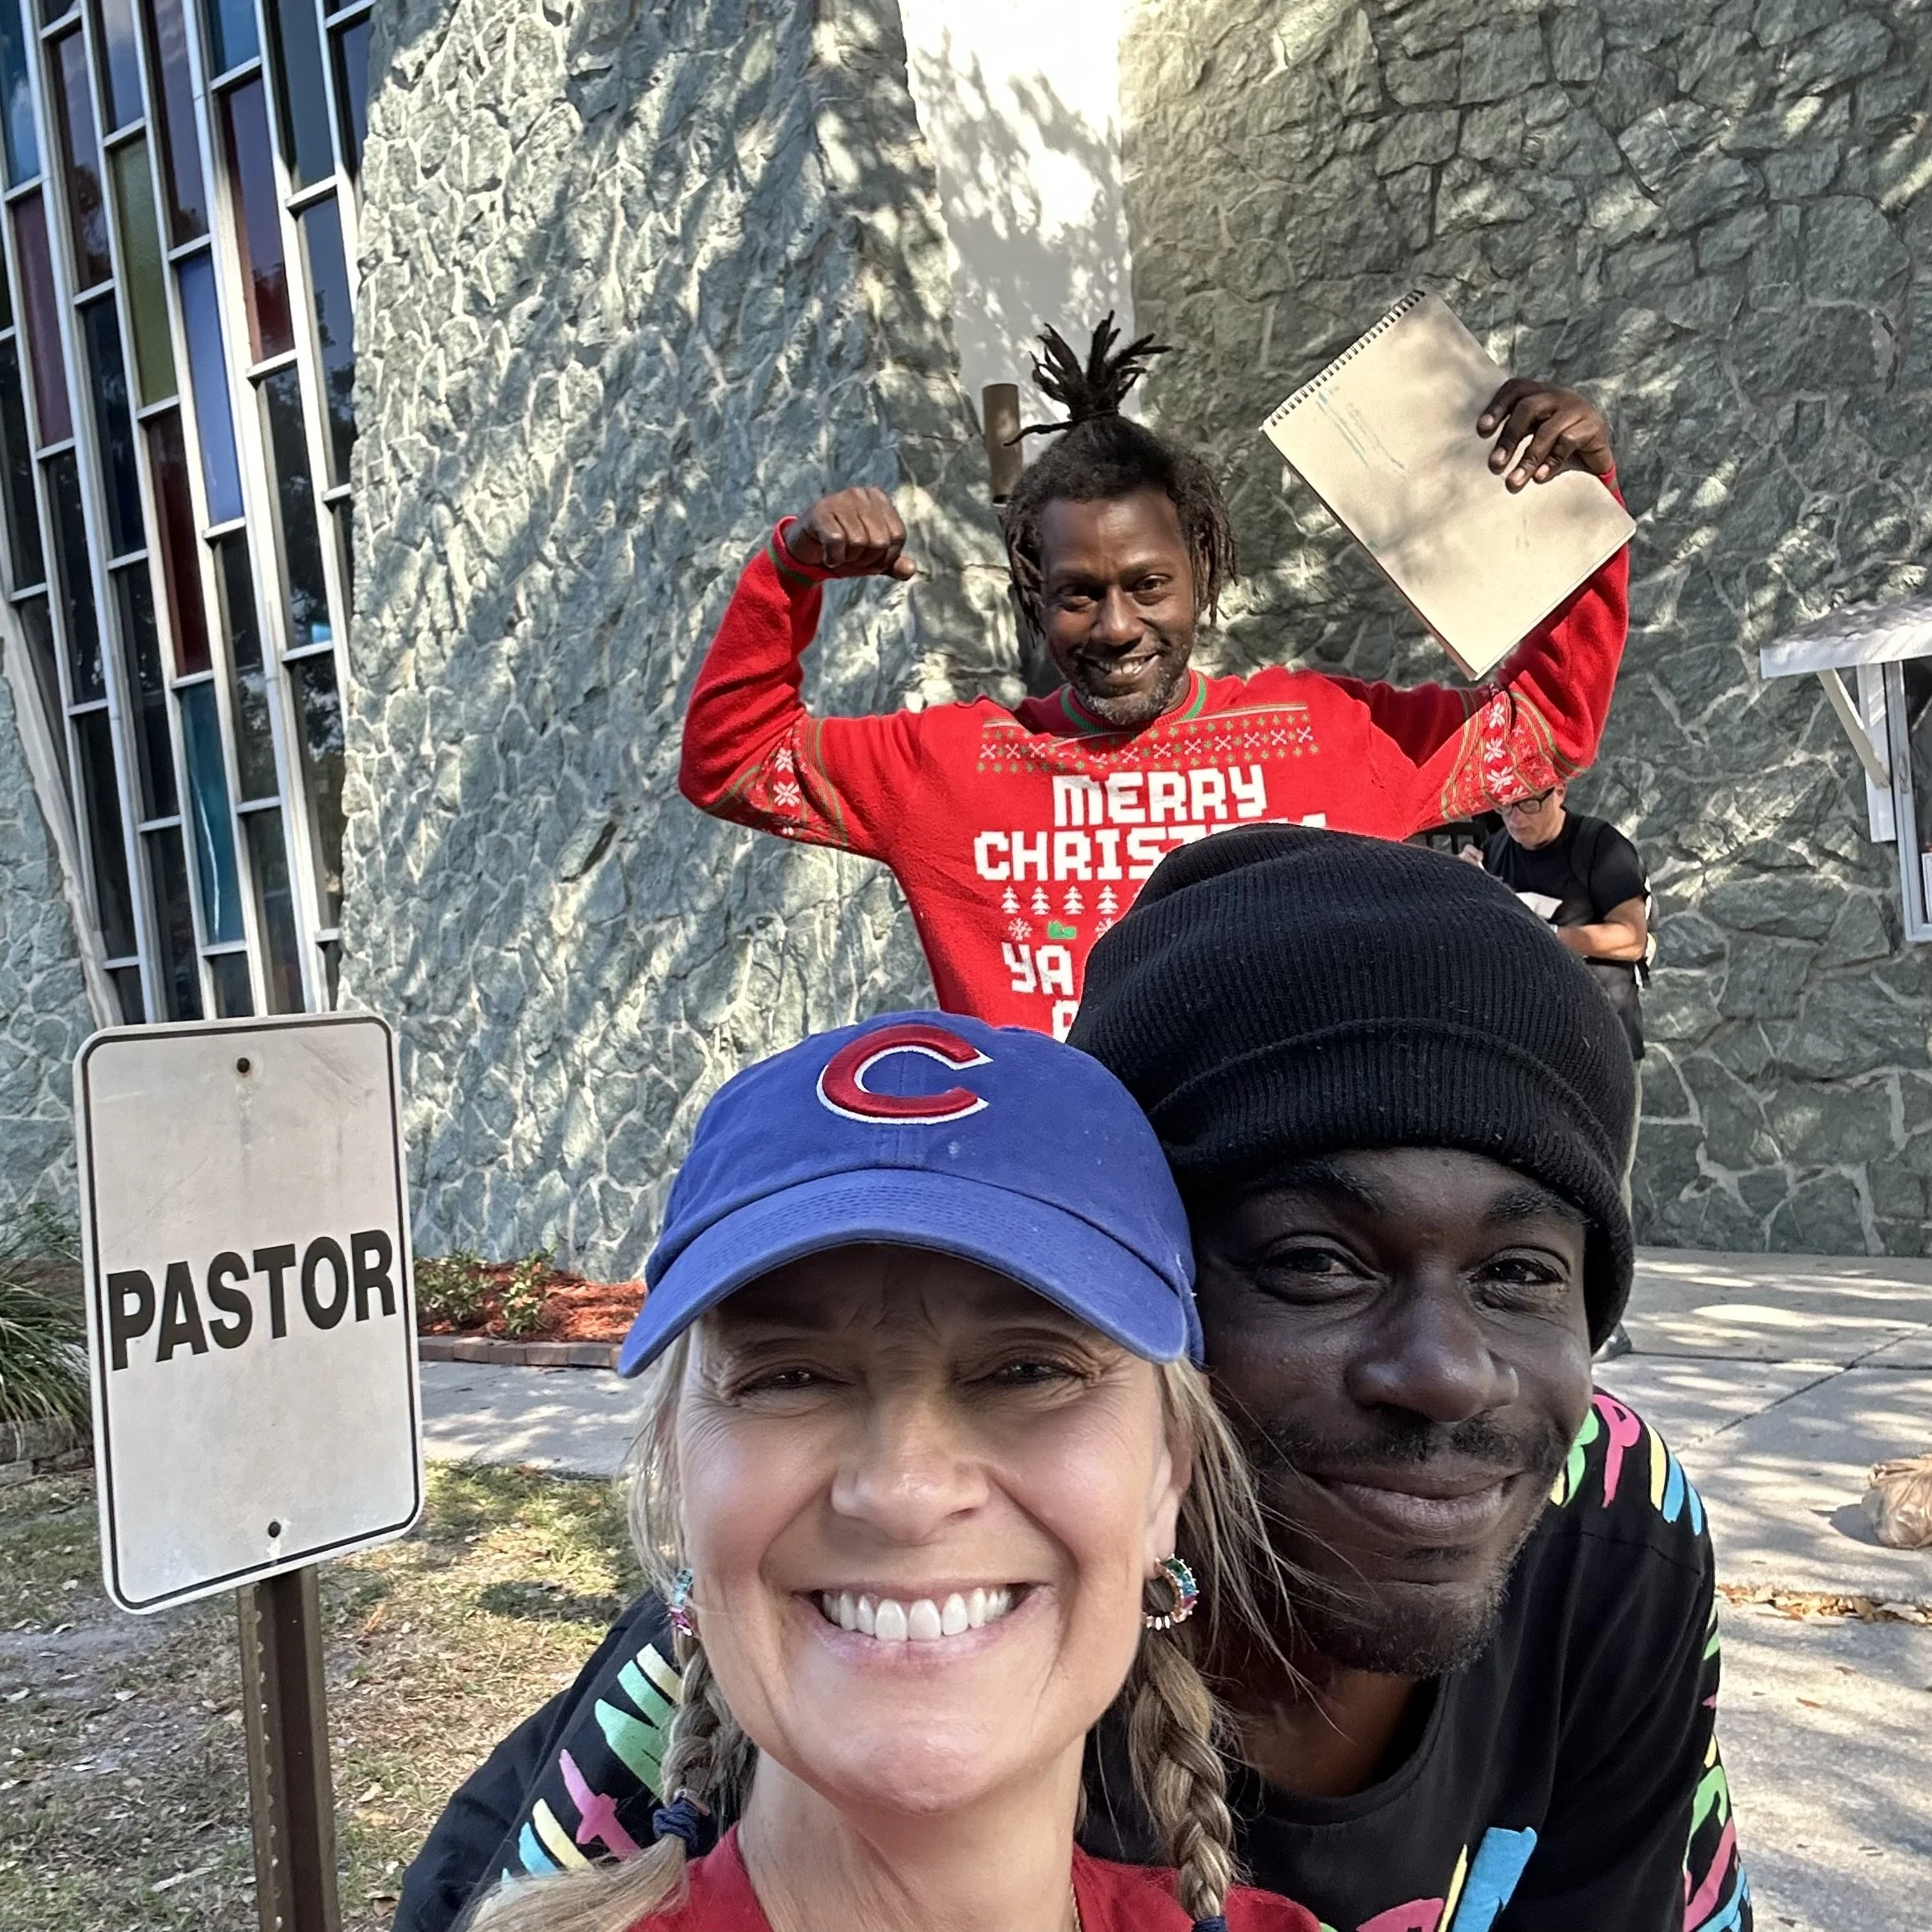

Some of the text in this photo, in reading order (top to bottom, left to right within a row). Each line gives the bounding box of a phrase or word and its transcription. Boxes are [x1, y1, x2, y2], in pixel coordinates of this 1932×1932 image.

[1053, 763, 1268, 827] MERRY
[974, 814, 1327, 882] CHRIS
[1001, 940, 1074, 997] YA
[816, 1024, 994, 1124] C
[105, 1229, 397, 1371] PASTOR
